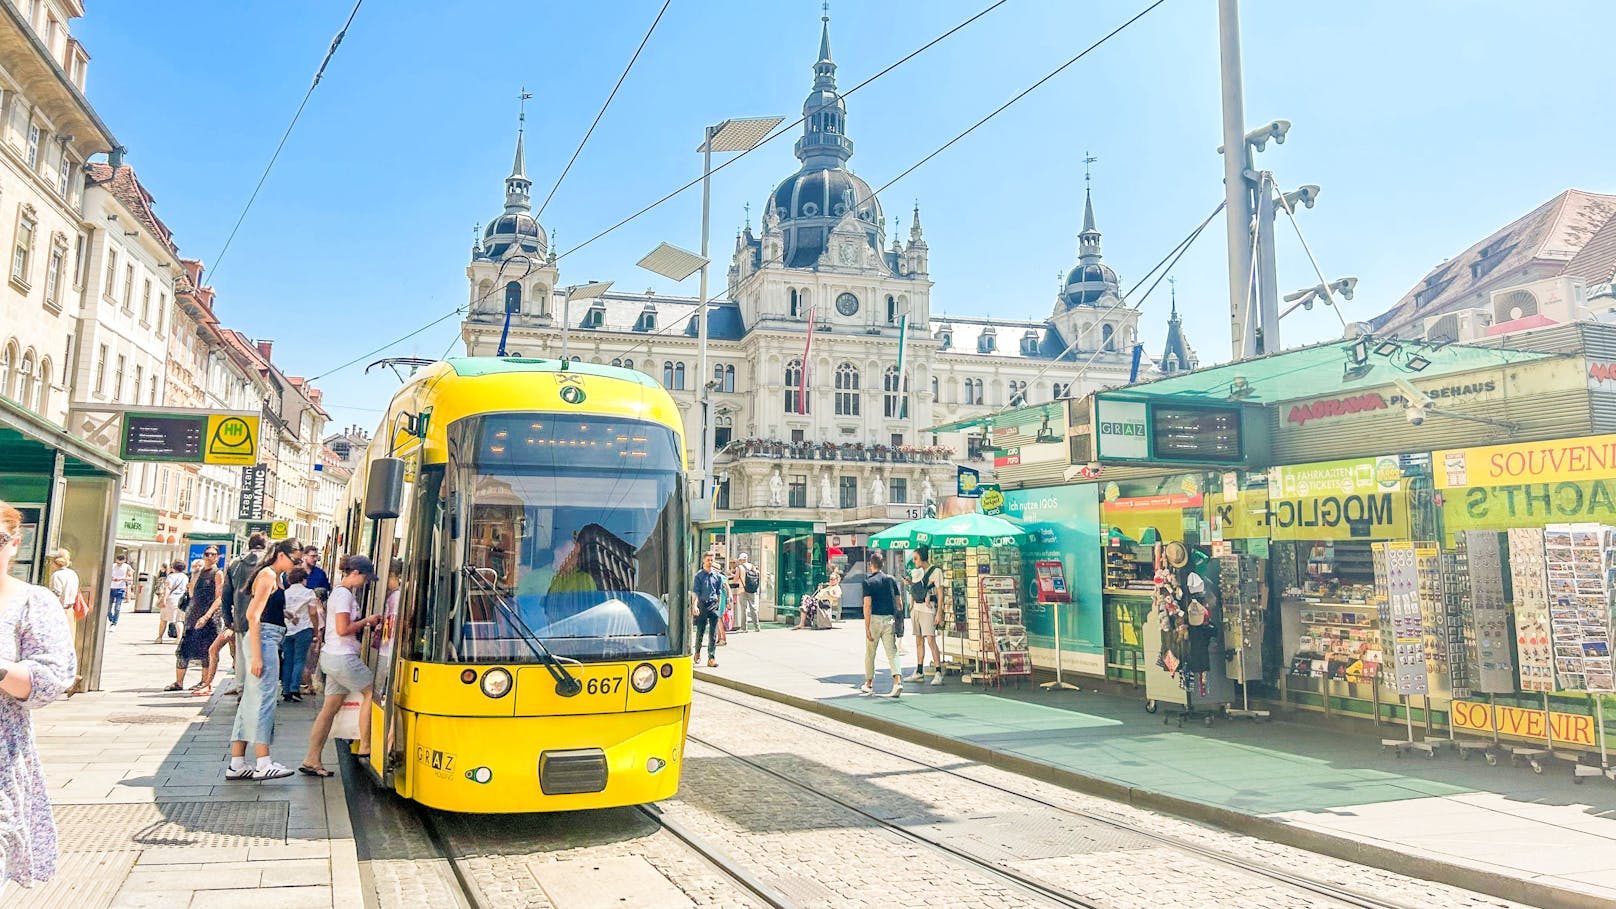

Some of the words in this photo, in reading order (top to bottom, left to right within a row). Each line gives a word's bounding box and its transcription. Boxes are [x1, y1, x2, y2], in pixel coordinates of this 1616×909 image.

[1101, 422, 1145, 436] GRAZ
[1297, 467, 1353, 480] FAHRKARTEN
[1308, 480, 1343, 490] TICKETS
[252, 470, 265, 519] HUMANIC
[240, 493, 252, 516] Frag
[1009, 502, 1019, 511] Ich
[1020, 501, 1038, 510] nutze
[906, 509, 918, 519] 15
[889, 540, 910, 549] LOTTO
[945, 537, 969, 545] LOTTO
[587, 677, 622, 695] 667
[1455, 702, 1591, 743] SOUVENIR
[417, 746, 455, 771] GRAZ
